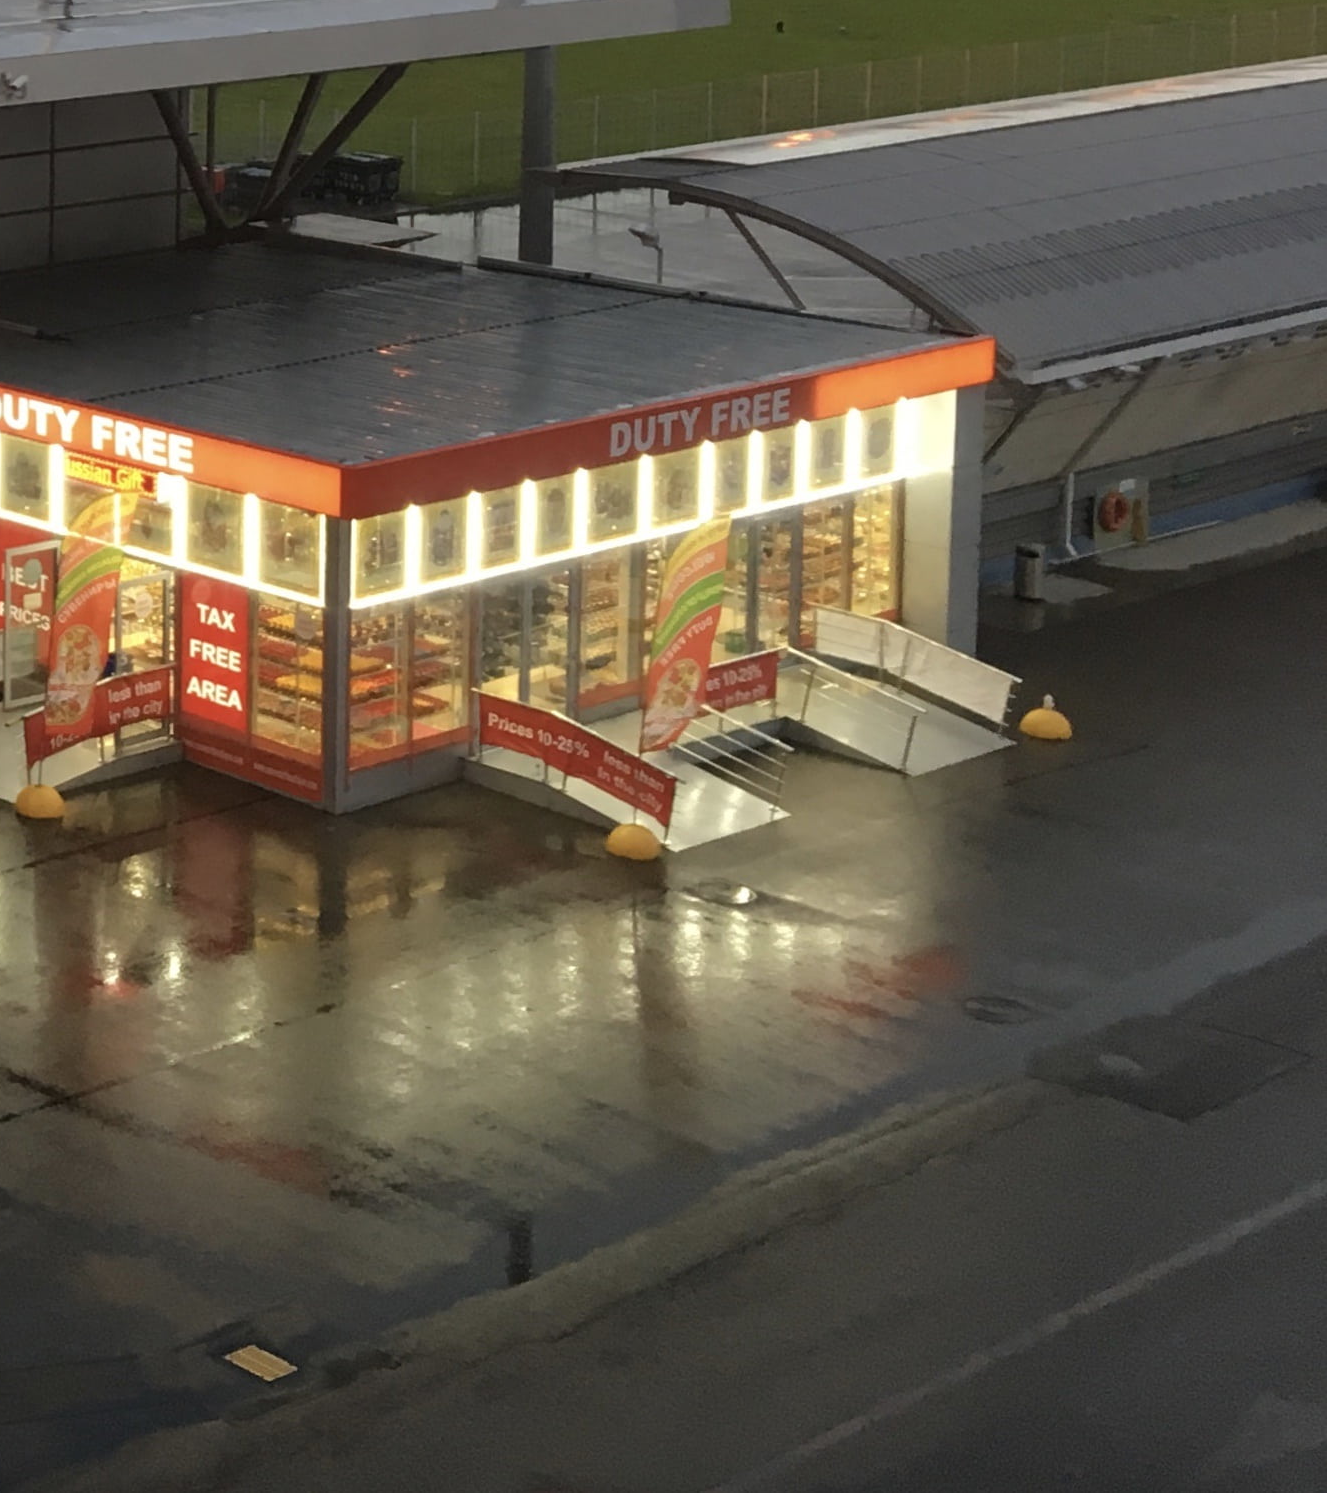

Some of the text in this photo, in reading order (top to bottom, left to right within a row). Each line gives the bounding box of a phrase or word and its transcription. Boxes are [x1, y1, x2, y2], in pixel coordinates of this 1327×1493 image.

[610, 388, 791, 458] DUTY FREE
[92, 414, 194, 473] FREE
[64, 459, 144, 490] ussian Gift
[1, 562, 50, 593] BET
[196, 603, 236, 633] TAX
[189, 638, 242, 673] FREE
[108, 680, 162, 704] less than
[186, 675, 243, 712] AREA
[488, 712, 591, 759] Prices 10-25%
[603, 750, 666, 794] less than
